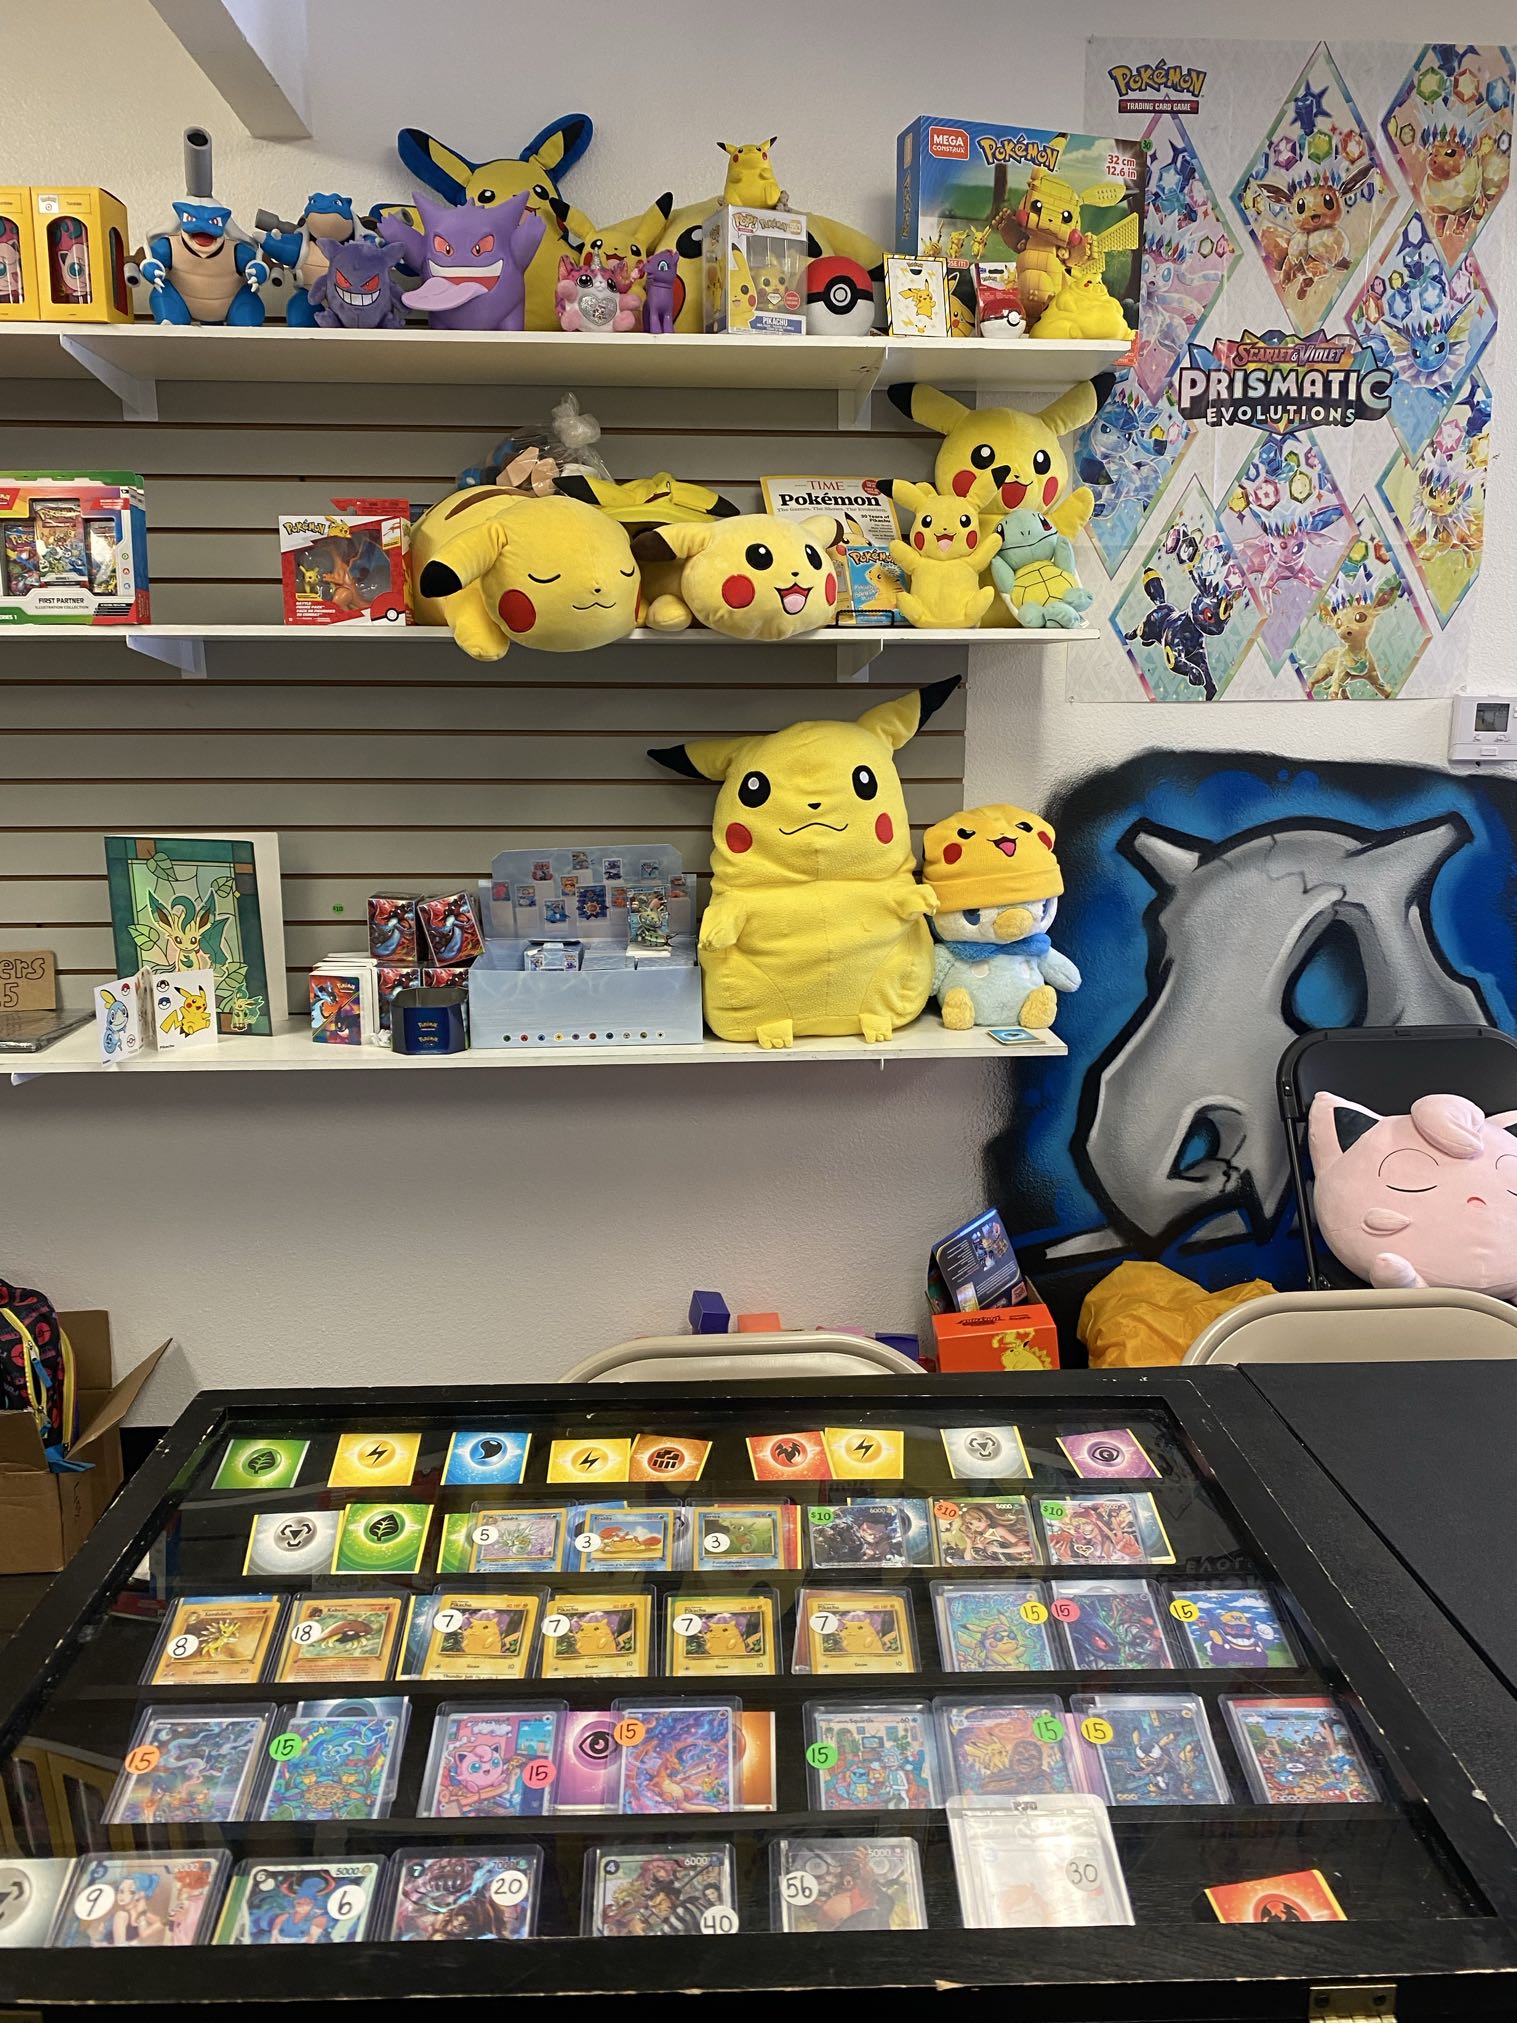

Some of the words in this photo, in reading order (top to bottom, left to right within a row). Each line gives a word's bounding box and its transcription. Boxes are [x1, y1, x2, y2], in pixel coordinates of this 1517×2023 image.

[1108, 58, 1206, 97] Pokémon
[934, 134, 964, 146] MEGA
[932, 144, 965, 154] CONSTRUX
[977, 134, 1060, 172] Pokémon
[1108, 154, 1120, 165] 32
[1122, 158, 1135, 167] cm
[1106, 166, 1125, 178] 12.6
[1127, 168, 1137, 178] in
[762, 316, 788, 326] PIKACHU
[1232, 342, 1290, 367] SCARLET
[1290, 350, 1298, 360] &
[1296, 344, 1346, 366] VIOLET
[1179, 367, 1392, 413] PRISMATIC
[1206, 405, 1356, 424] EVOLUTIONS
[808, 480, 845, 490] TIME
[779, 493, 881, 506] Pokémon
[283, 519, 325, 535] Pokémon
[10, 534, 36, 545] Poké
[0, 982, 18, 1008] 5
[810, 1512, 831, 1521] $10
[937, 1506, 956, 1518] $10
[1043, 1504, 1063, 1517] $10
[480, 1529, 490, 1541] 5
[582, 1536, 591, 1548] 3
[712, 1536, 720, 1548] 3
[1023, 1605, 1040, 1621] 15
[1054, 1604, 1070, 1618] 15
[1173, 1604, 1193, 1619] 15
[442, 1615, 454, 1627] 7
[549, 1620, 561, 1633] 7
[681, 1618, 693, 1631] 7
[816, 1616, 828, 1631] 7
[295, 1625, 312, 1641] 18
[173, 1638, 187, 1656] 8
[618, 1723, 638, 1740] 15
[1036, 1722, 1057, 1740] 15
[1086, 1723, 1107, 1740] 15
[274, 1739, 295, 1755] 15
[811, 1746, 828, 1763] 15
[128, 1752, 155, 1771] 15
[529, 1765, 548, 1781] 15
[607, 1861, 616, 1872] 4
[684, 1856, 708, 1866] 6000
[336, 1867, 360, 1876] 5000
[413, 1866, 422, 1876] 7
[1069, 1862, 1097, 1883] 30
[494, 1878, 522, 1895] 20
[786, 1875, 813, 1898] 56
[86, 1888, 101, 1916] 9
[338, 1894, 351, 1916] 6
[704, 1916, 732, 1933] 40
